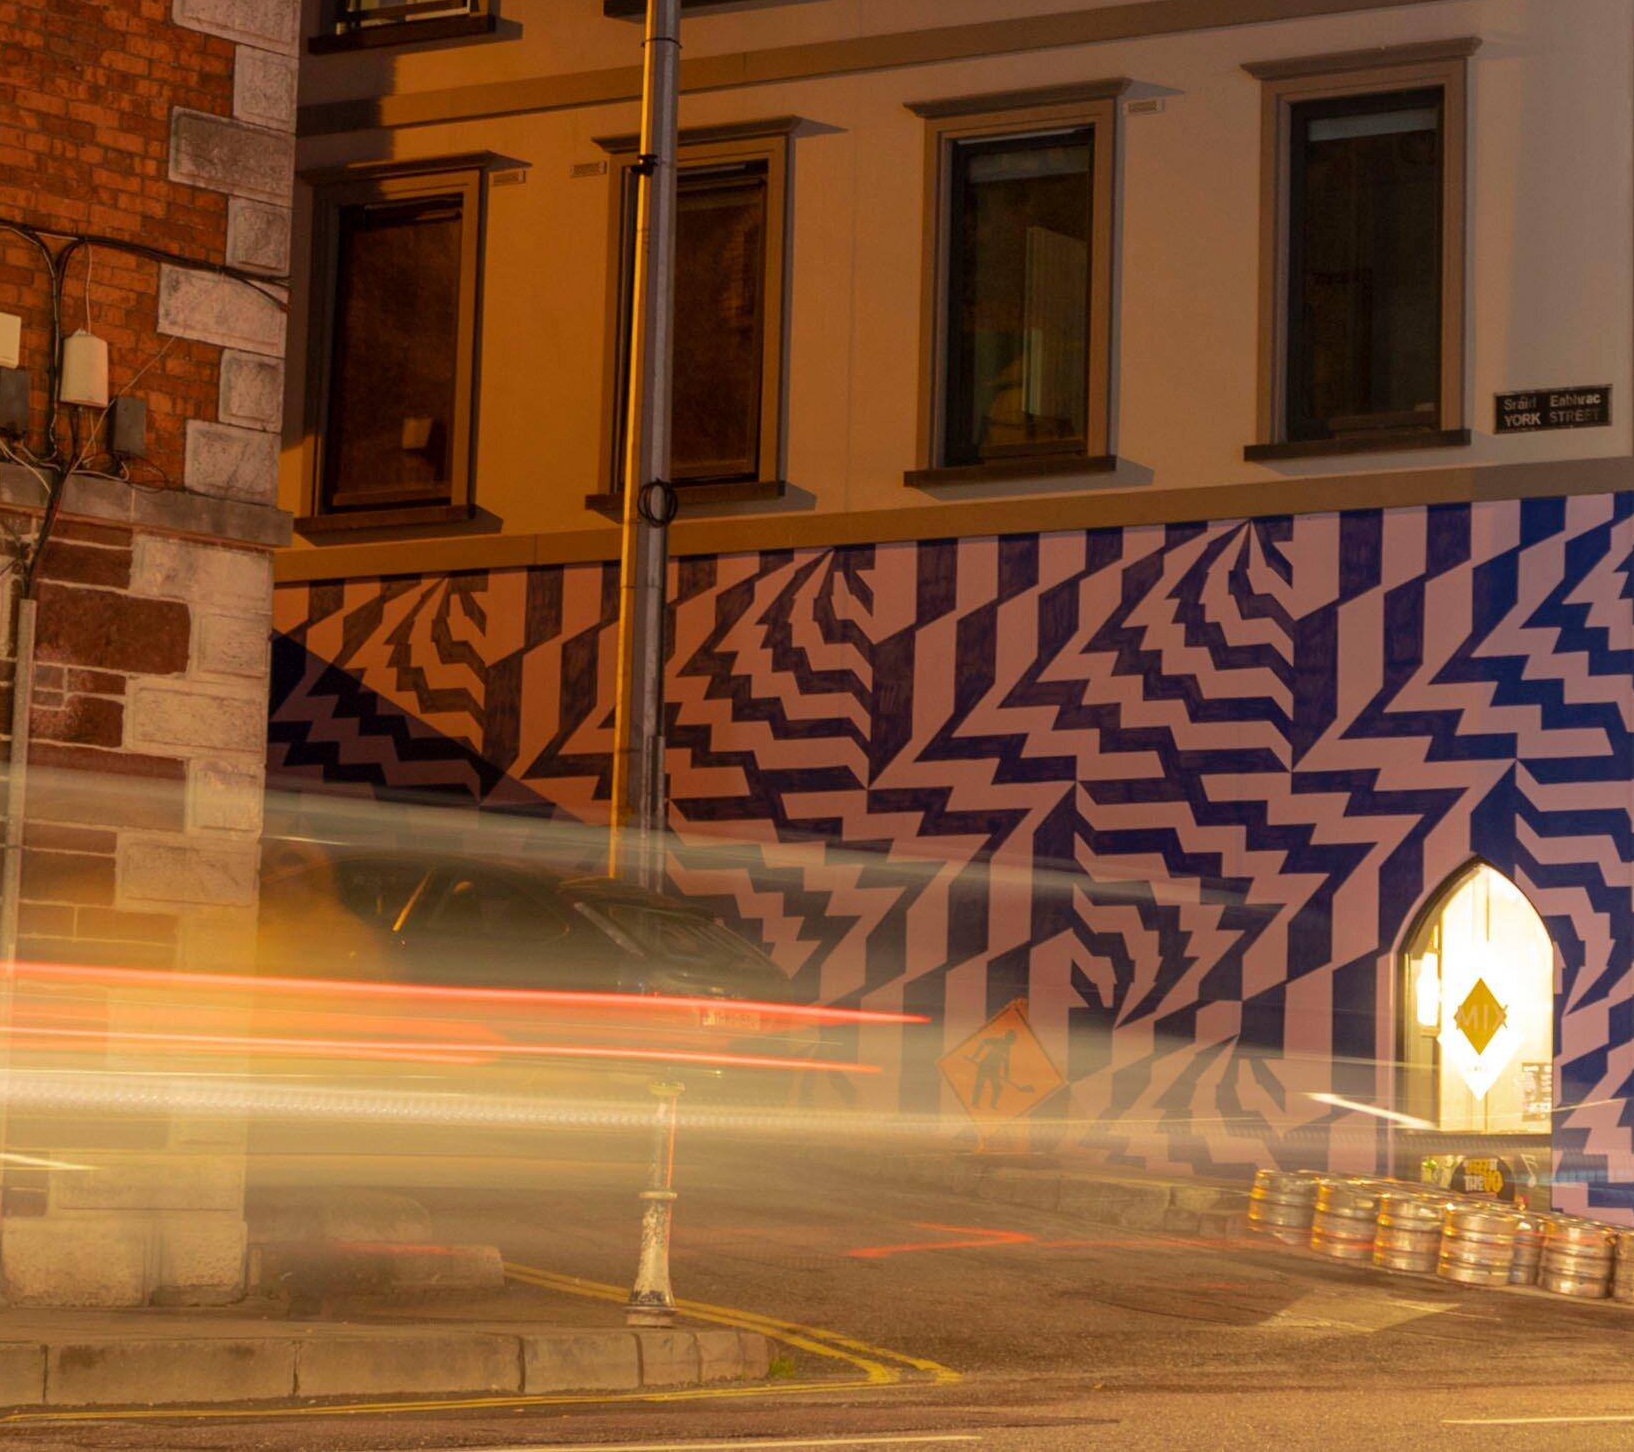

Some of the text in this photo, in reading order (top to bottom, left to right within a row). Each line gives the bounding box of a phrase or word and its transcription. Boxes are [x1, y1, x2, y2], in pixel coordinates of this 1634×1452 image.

[1504, 408, 1600, 427] YORK STREET
[1455, 1004, 1509, 1030] MIX
